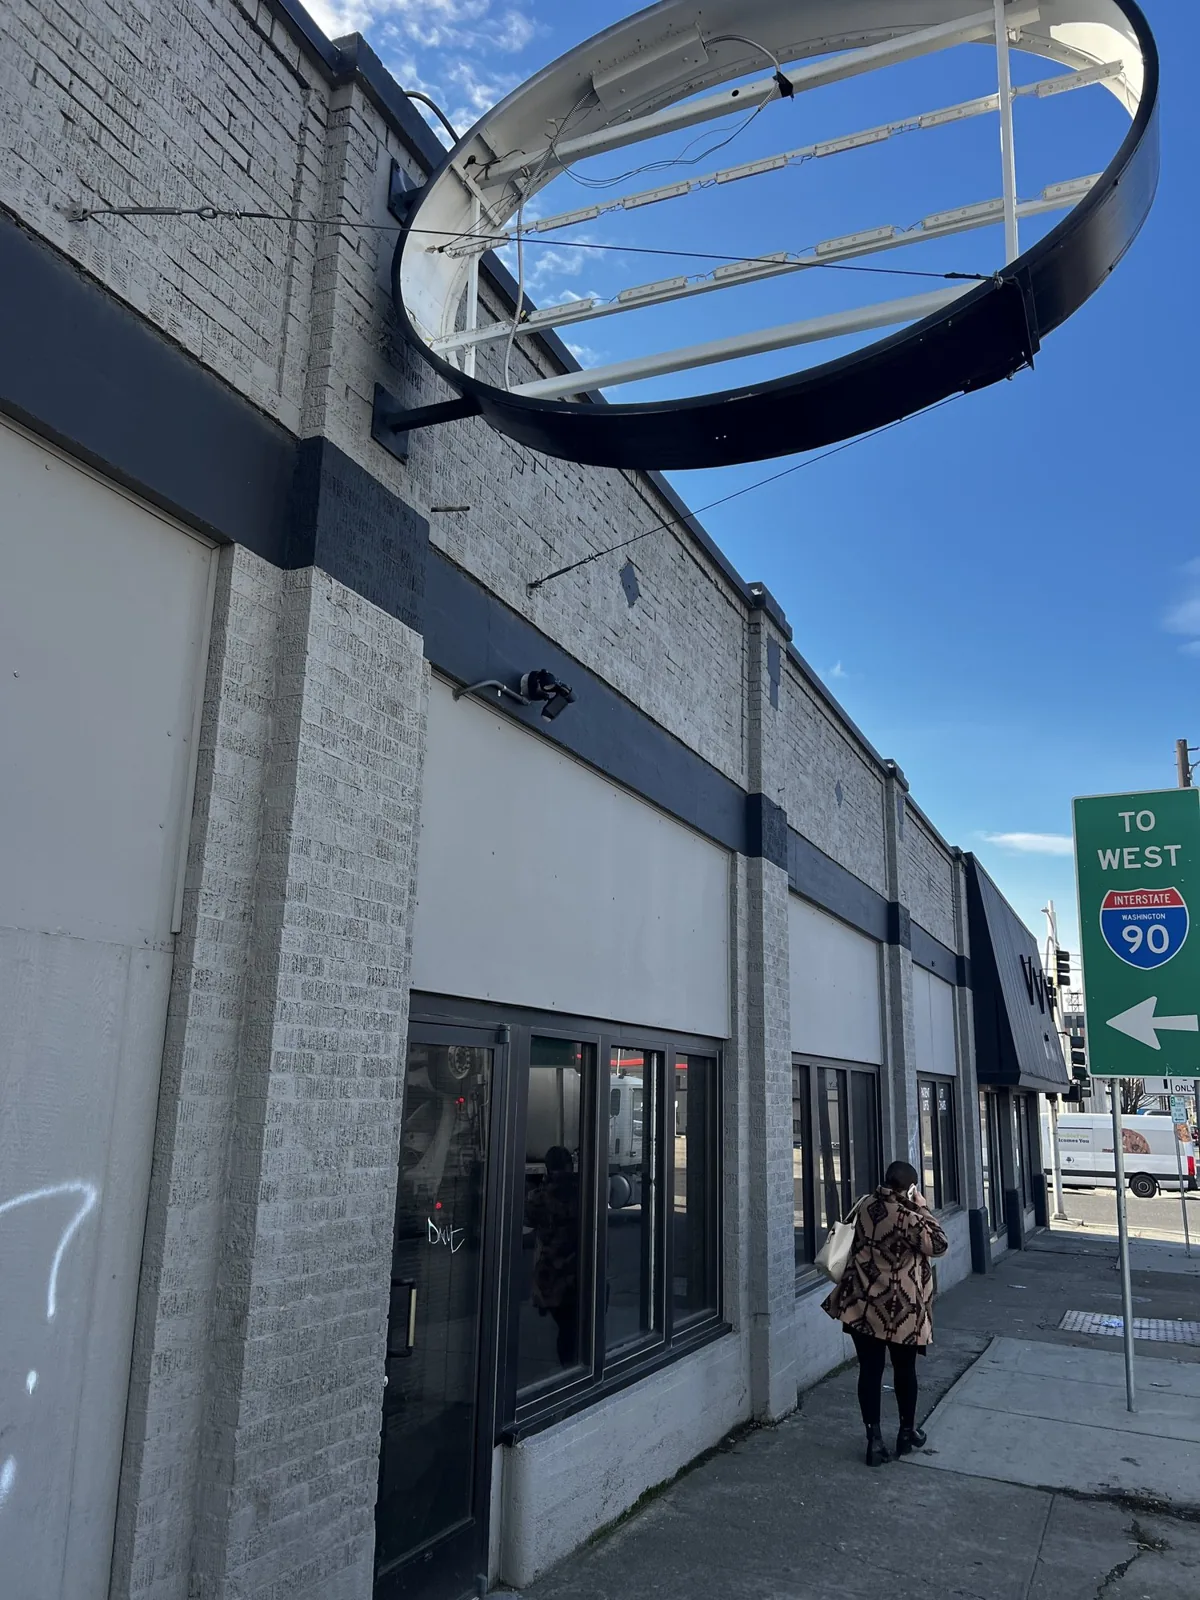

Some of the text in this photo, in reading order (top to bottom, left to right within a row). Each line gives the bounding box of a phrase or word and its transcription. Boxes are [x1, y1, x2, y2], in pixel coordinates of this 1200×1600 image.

[1118, 810, 1156, 833] TO
[1097, 844, 1182, 870] WEST
[1114, 893, 1171, 905] INTERSTATE
[1121, 913, 1166, 921] WASHINGTON
[1122, 924, 1169, 954] 90
[1175, 1084, 1195, 1092] ONLY
